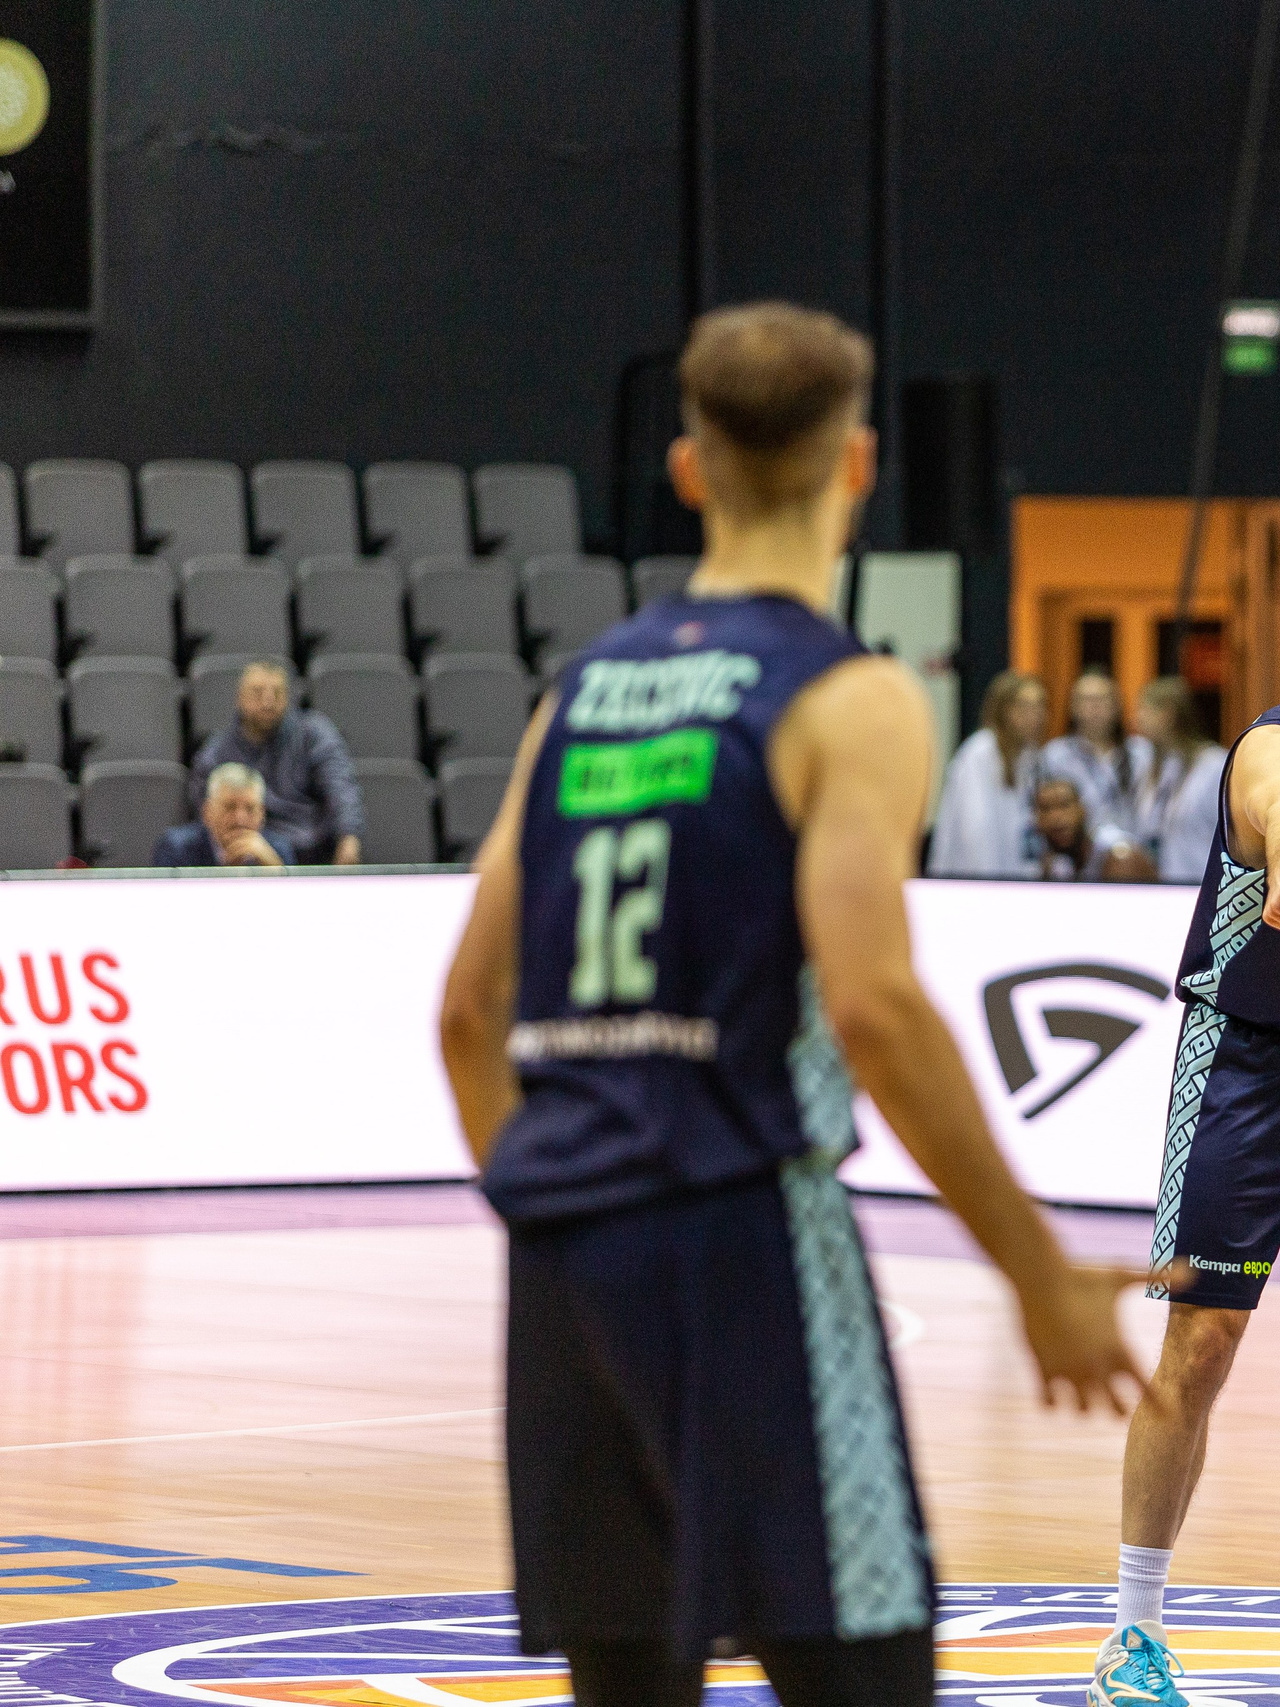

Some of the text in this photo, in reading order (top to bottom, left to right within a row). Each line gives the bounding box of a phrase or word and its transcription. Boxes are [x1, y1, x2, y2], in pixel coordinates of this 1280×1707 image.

[568, 817, 672, 1007] 12
[0, 1039, 148, 1115] ORS
[1189, 1254, 1241, 1275] Kempa
